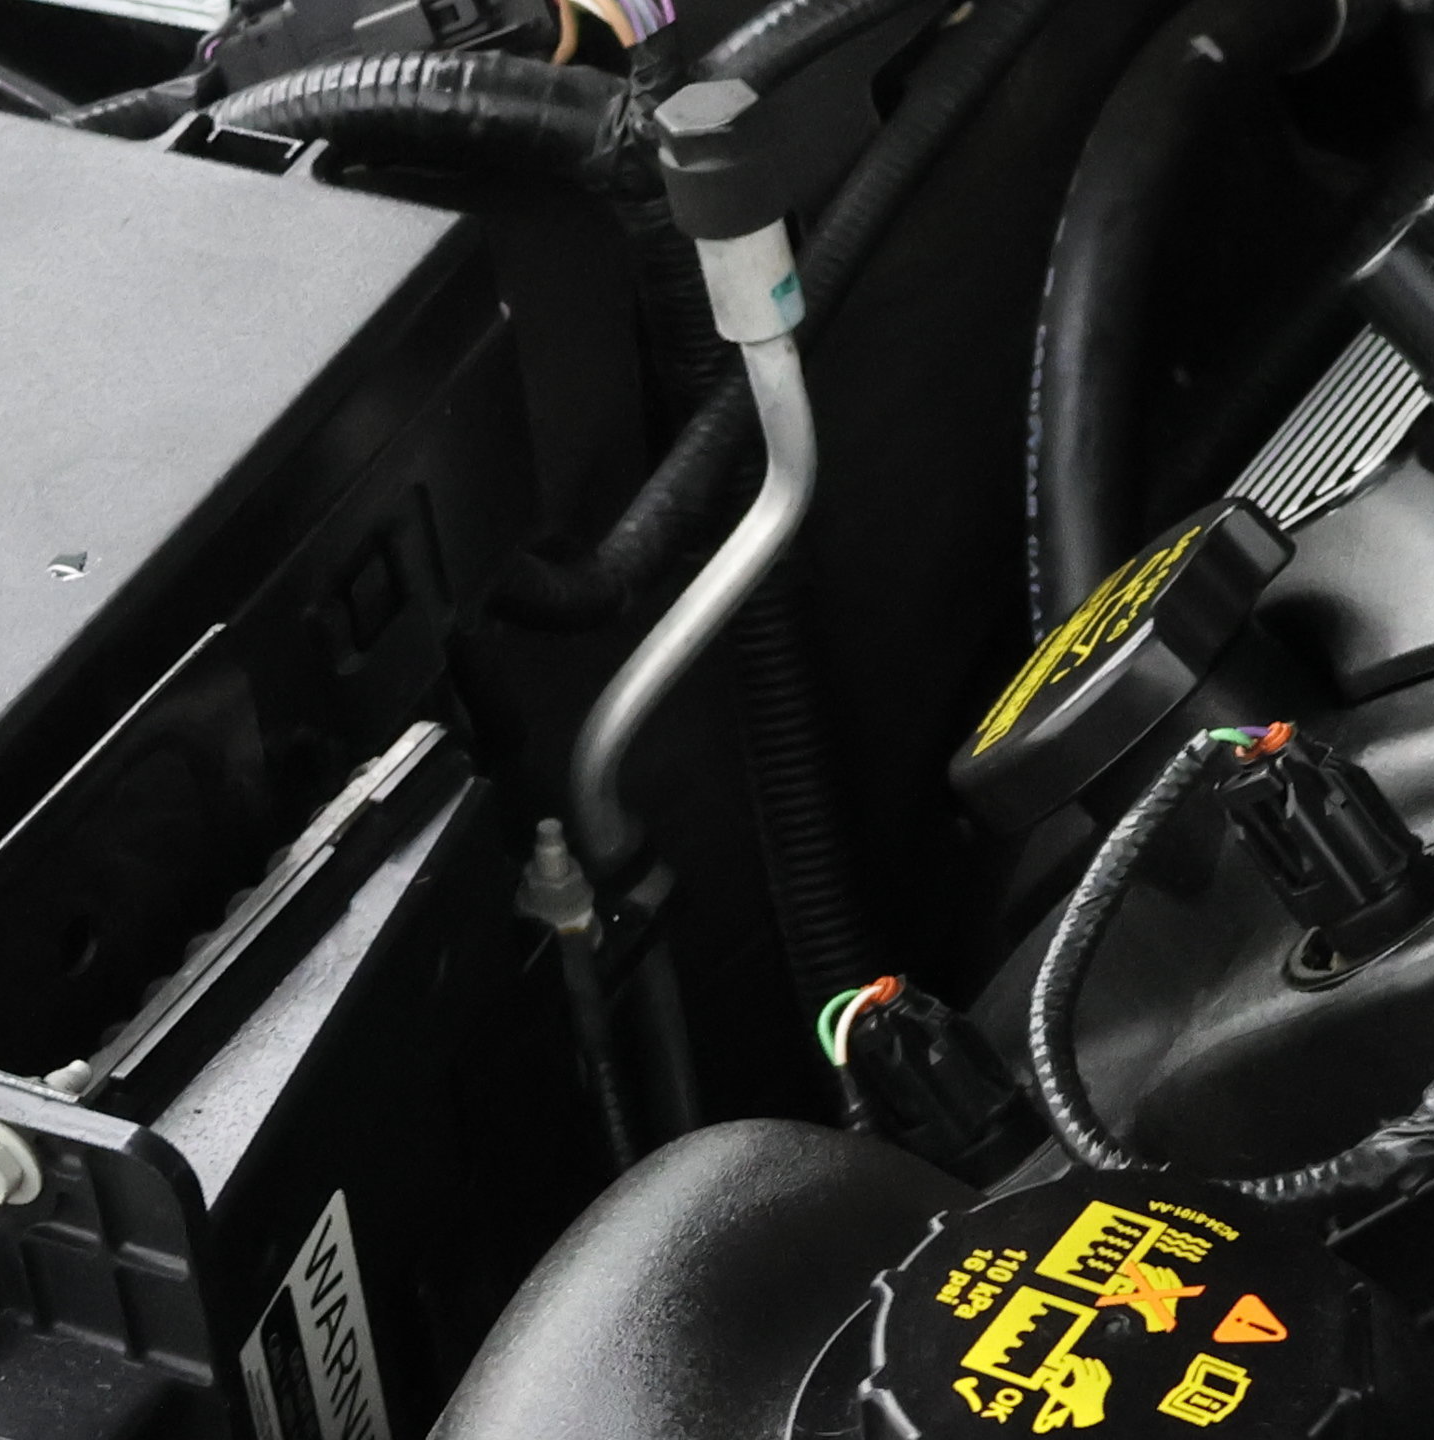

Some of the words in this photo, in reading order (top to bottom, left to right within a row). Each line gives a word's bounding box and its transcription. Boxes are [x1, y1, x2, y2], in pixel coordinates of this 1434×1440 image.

[963, 1248, 994, 1272] 16
[986, 1248, 1028, 1283] 110
[935, 1269, 971, 1306] psi
[953, 1281, 1003, 1319] kPa
[980, 1387, 1024, 1424] OK
